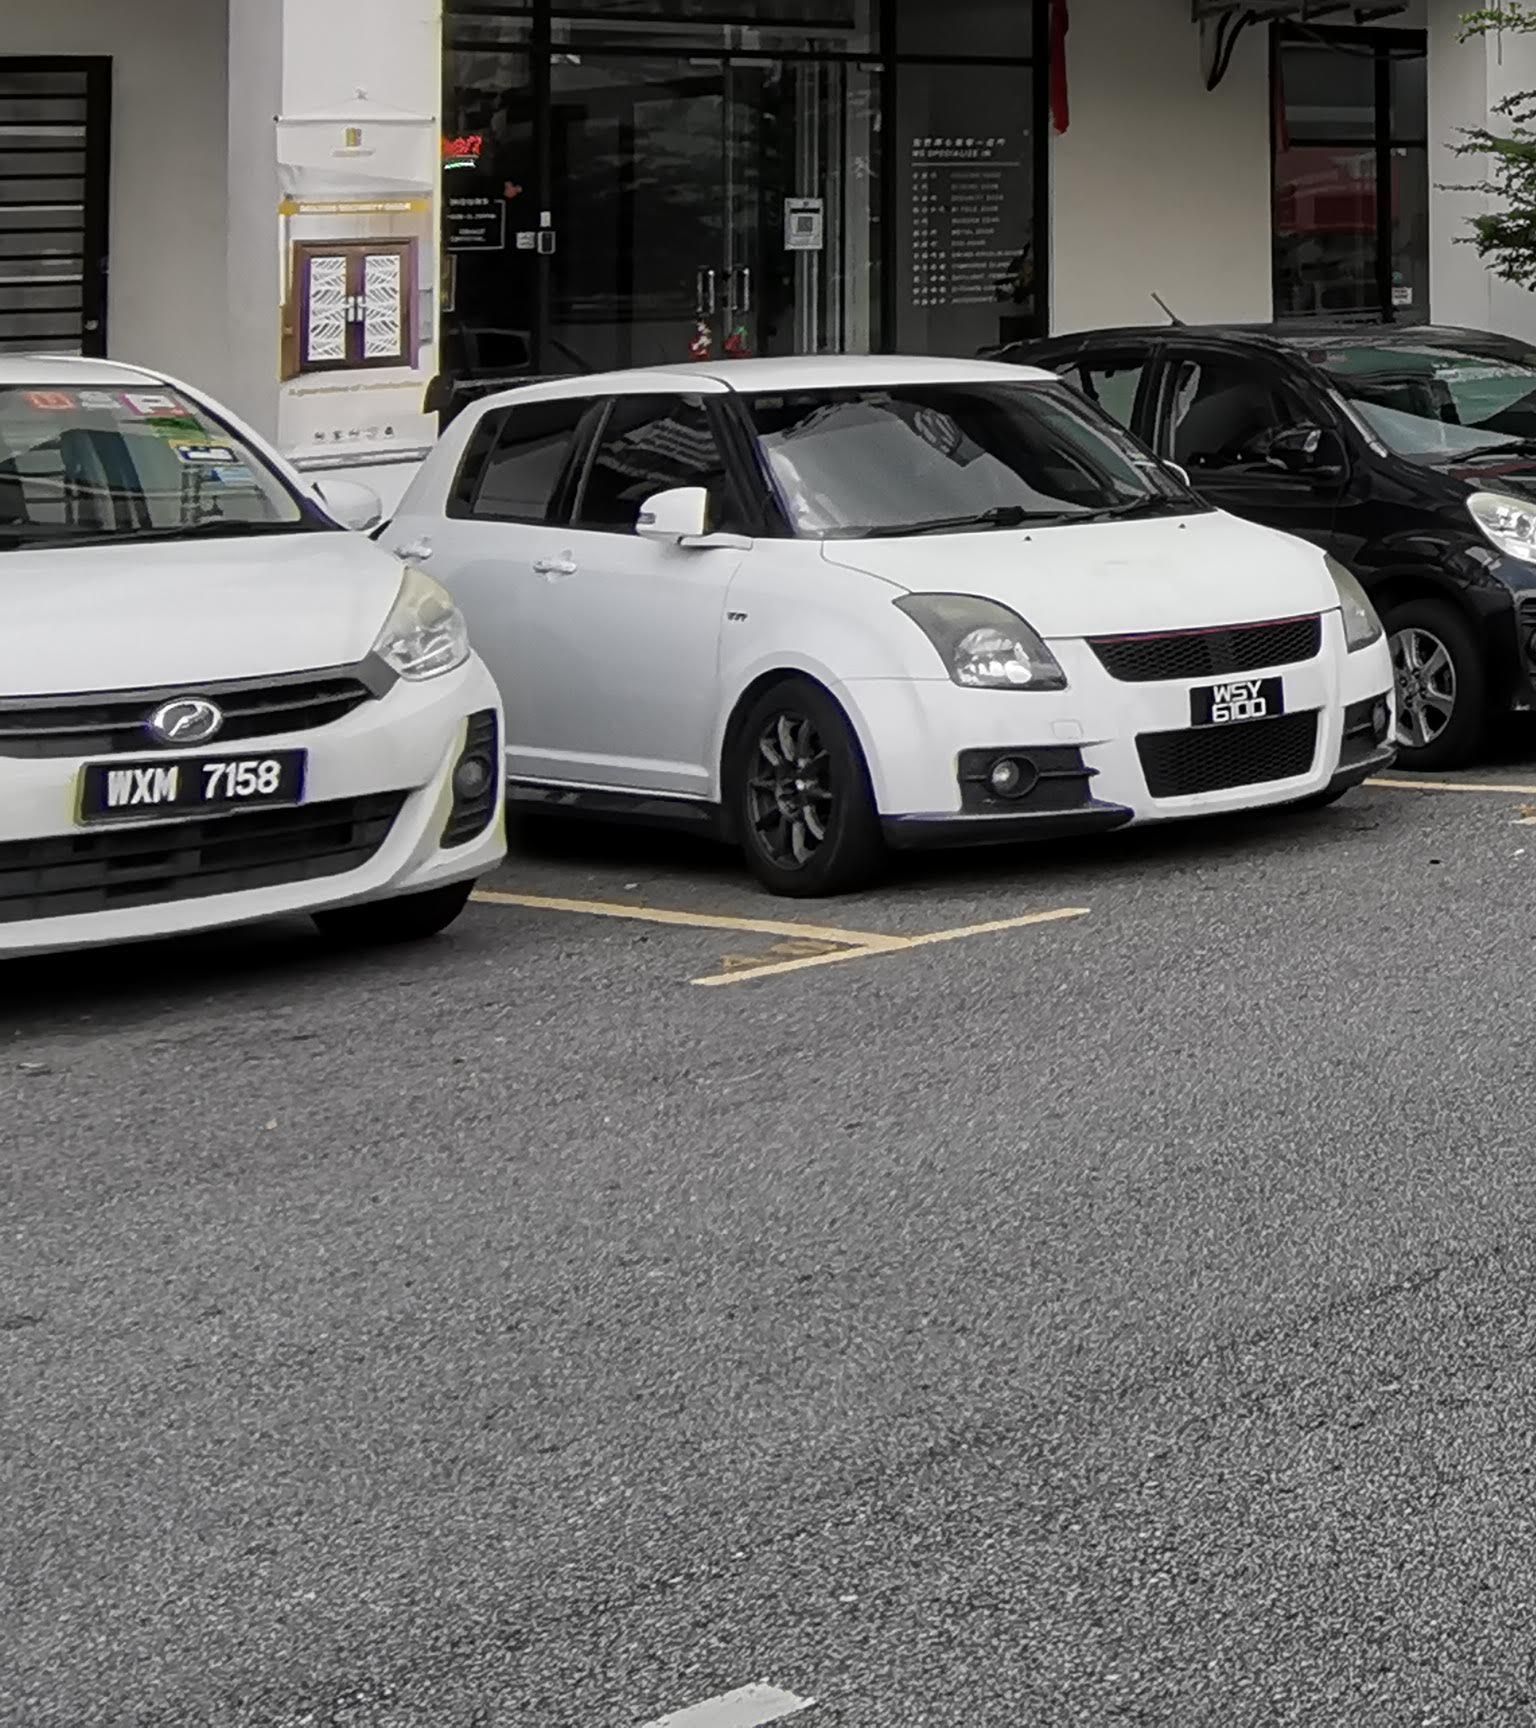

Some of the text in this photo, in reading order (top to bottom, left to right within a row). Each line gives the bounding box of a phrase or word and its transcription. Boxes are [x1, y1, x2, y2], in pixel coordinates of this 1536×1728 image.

[1212, 679, 1262, 703] WSY
[1211, 696, 1267, 723] 6100
[107, 758, 282, 807] WXM 7158
